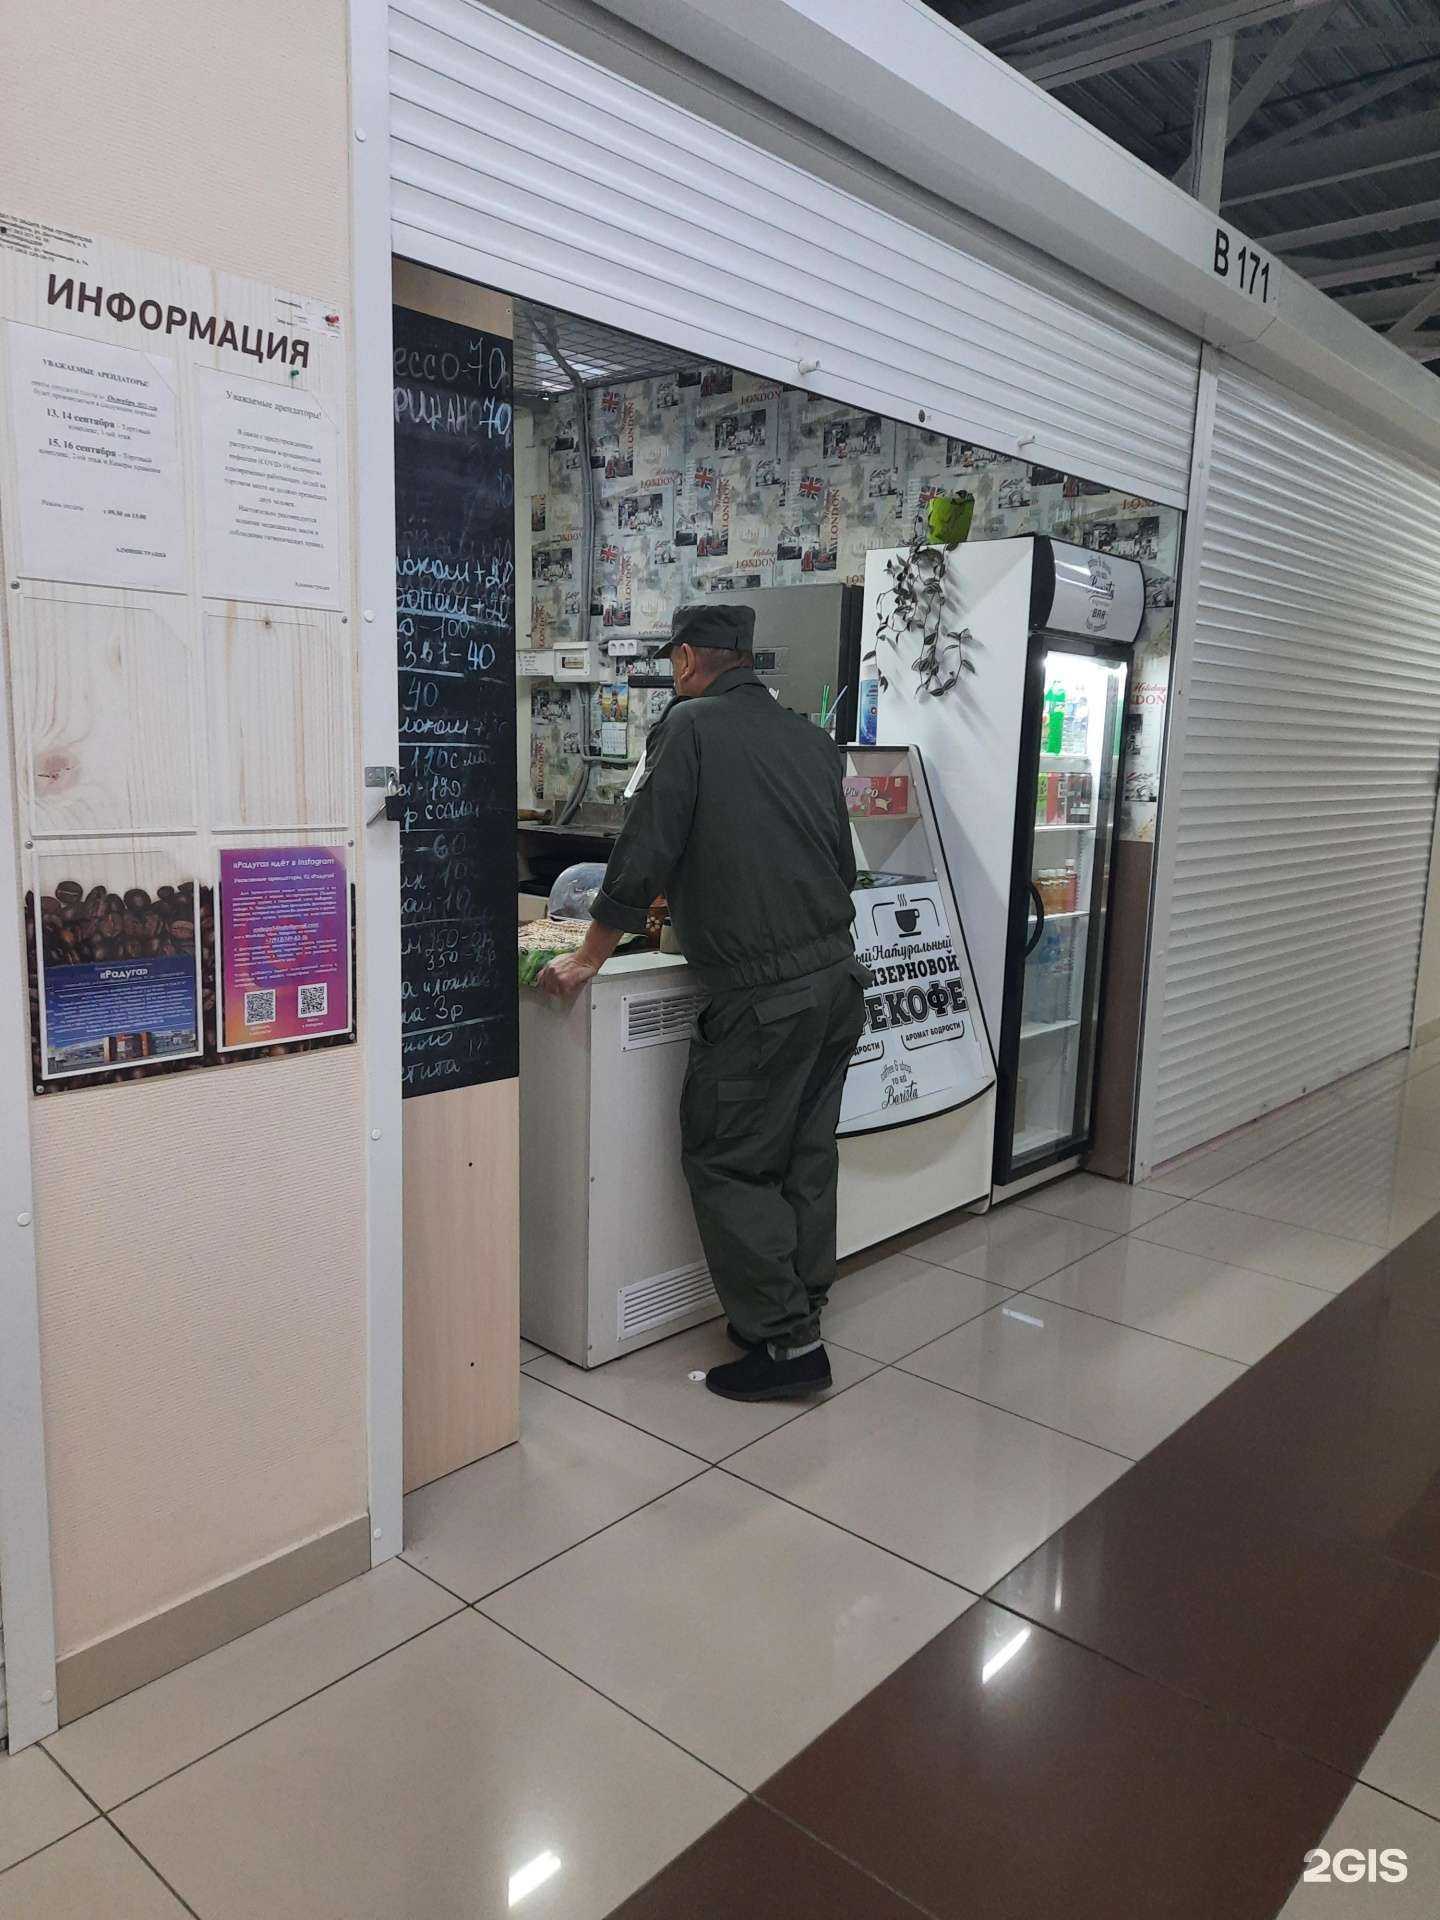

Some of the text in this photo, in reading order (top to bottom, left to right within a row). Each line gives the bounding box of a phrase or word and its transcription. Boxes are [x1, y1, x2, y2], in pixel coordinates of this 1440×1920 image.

[1238, 246, 1270, 303] 171
[47, 273, 310, 369] ИНФОРМАЦИЯ
[225, 389, 272, 409] Уважаемые
[873, 935, 953, 961] Натуральный
[100, 968, 148, 979] «Радуга»
[905, 1021, 961, 1041] АРОМАТ БОДРОСТИ
